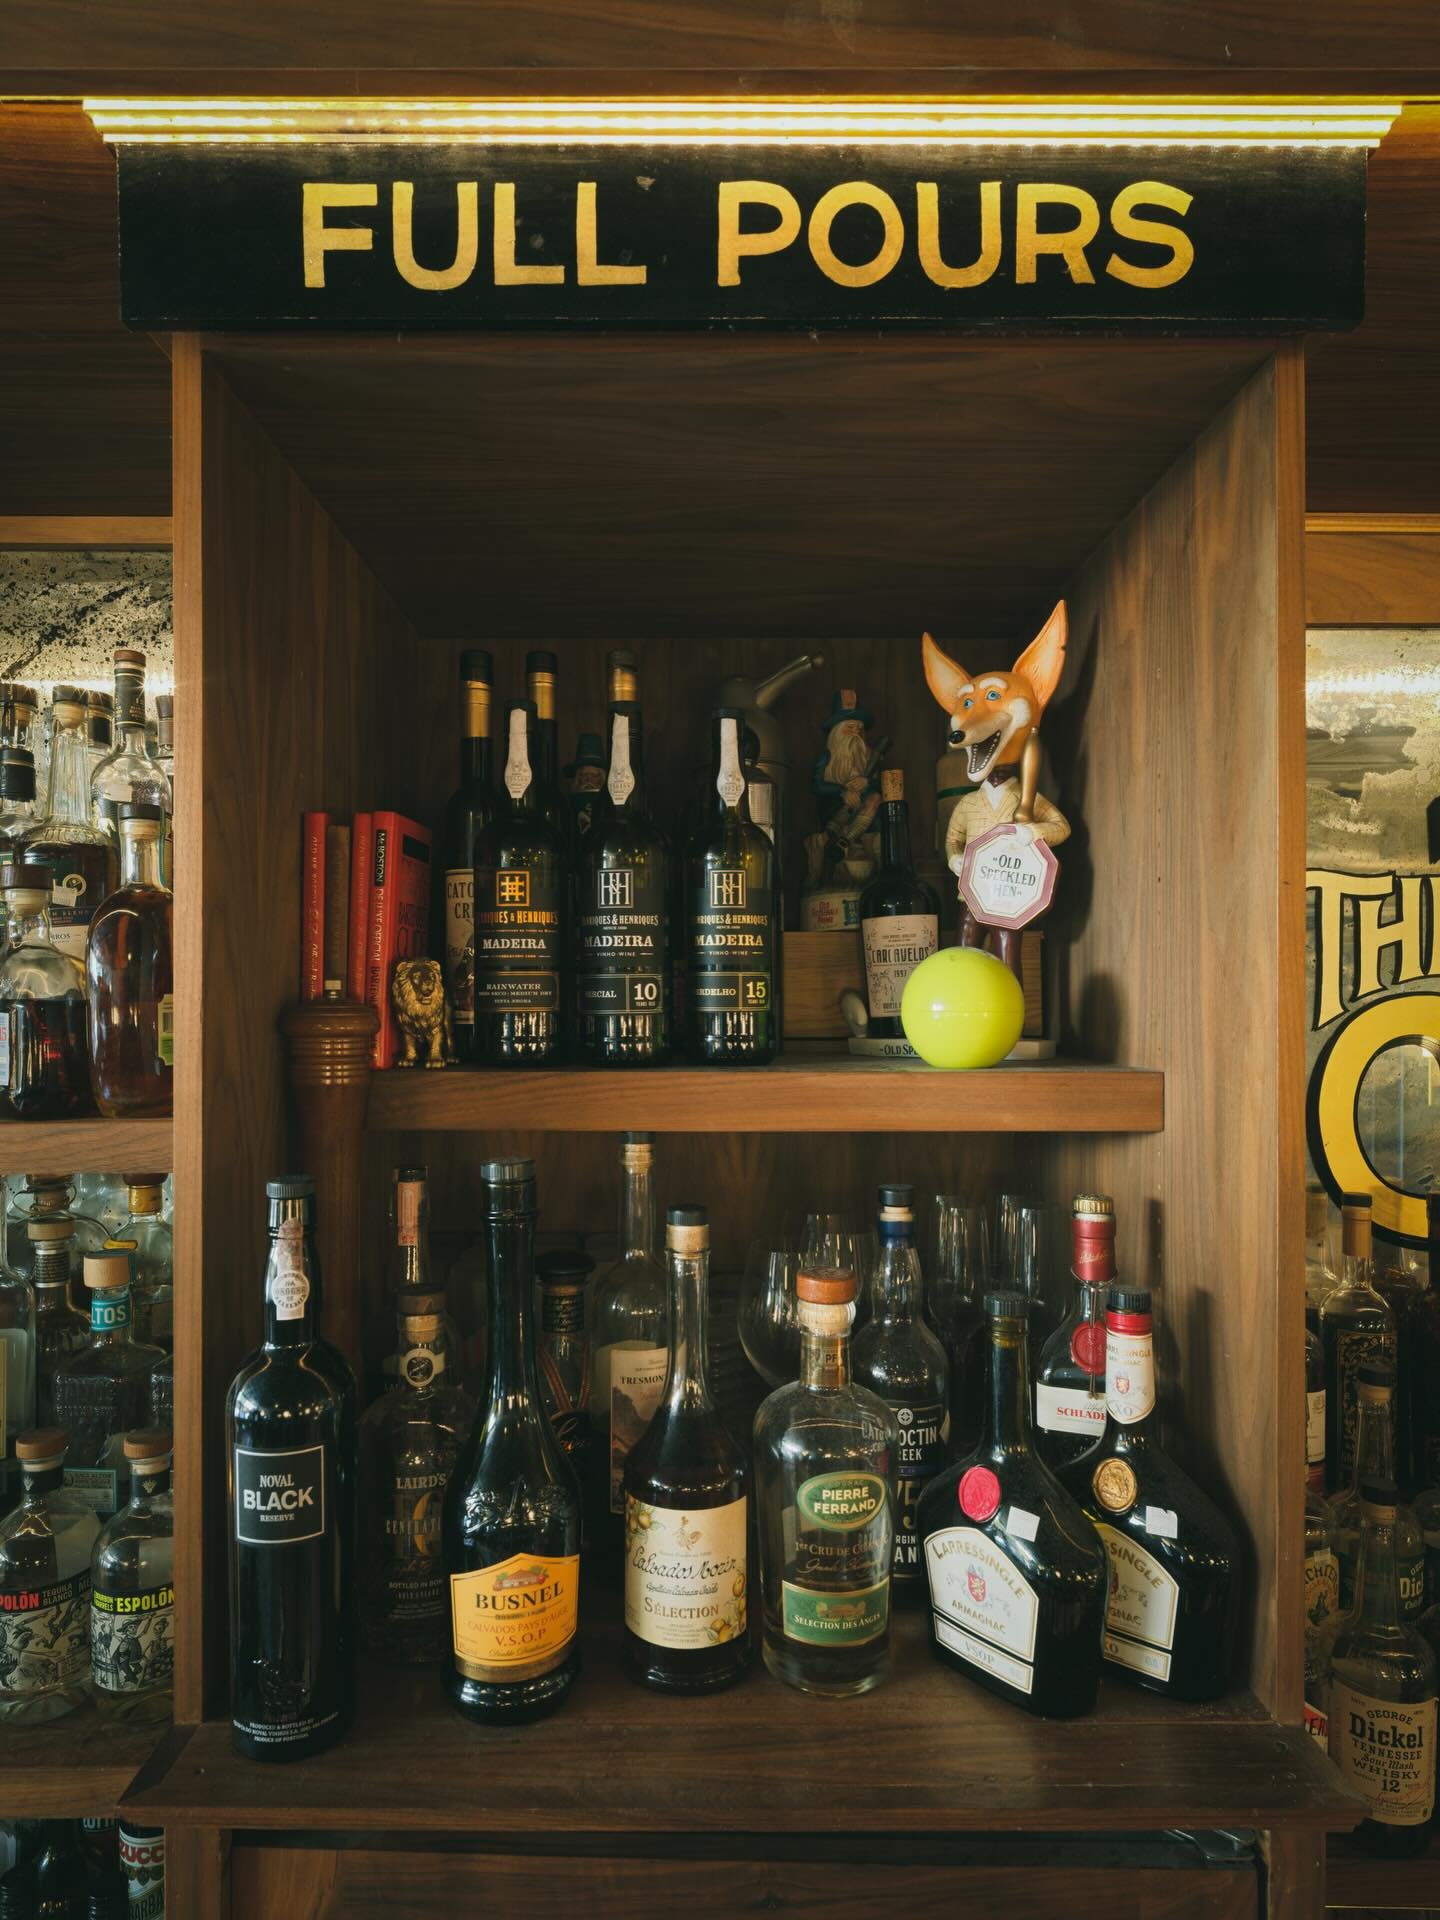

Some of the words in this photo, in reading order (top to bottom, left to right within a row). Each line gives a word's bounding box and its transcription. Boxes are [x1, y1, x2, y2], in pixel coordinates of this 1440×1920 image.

[301, 181, 646, 289] FULL
[718, 180, 1195, 289] POURS
[375, 846, 385, 883] BOSTON
[980, 866, 1036, 887] SPECKLED
[454, 903, 473, 919] CR
[516, 911, 559, 926] HENRIQUES
[619, 915, 659, 926] HENRIQUES
[732, 915, 768, 926] HENRIQUES
[482, 939, 547, 949] MADEIRA
[584, 936, 654, 947] MADEIRA
[633, 983, 657, 1000] 10
[746, 982, 766, 998] 15
[897, 1448, 922, 1461] EEK
[259, 1473, 295, 1487] NOVAL
[396, 1472, 447, 1489] LAIRD'S
[243, 1486, 314, 1510] BLACK
[822, 1487, 869, 1500] PIERRE
[814, 1499, 876, 1514] FERRAND
[260, 1513, 295, 1521] RESERVE
[809, 1544, 833, 1556] CRU
[632, 1545, 692, 1580] Calvados
[43, 1583, 73, 1597] TEQUILA
[475, 1580, 564, 1611] BUSNEL
[794, 1614, 840, 1629] SELECTION
[843, 1621, 857, 1629] DES
[859, 1610, 880, 1626] ANGES
[951, 1599, 1007, 1635] ARMAGNAC
[468, 1619, 516, 1634] CALVADOS
[1366, 1709, 1413, 1725] GEORGE
[1350, 1712, 1424, 1748] Dickel
[1351, 1739, 1421, 1760] TENNESSEE
[1352, 1758, 1420, 1779] WHISKY
[1361, 1751, 1387, 1767] Sour
[1388, 1760, 1414, 1770] Mash
[1381, 1779, 1400, 1793] 12
